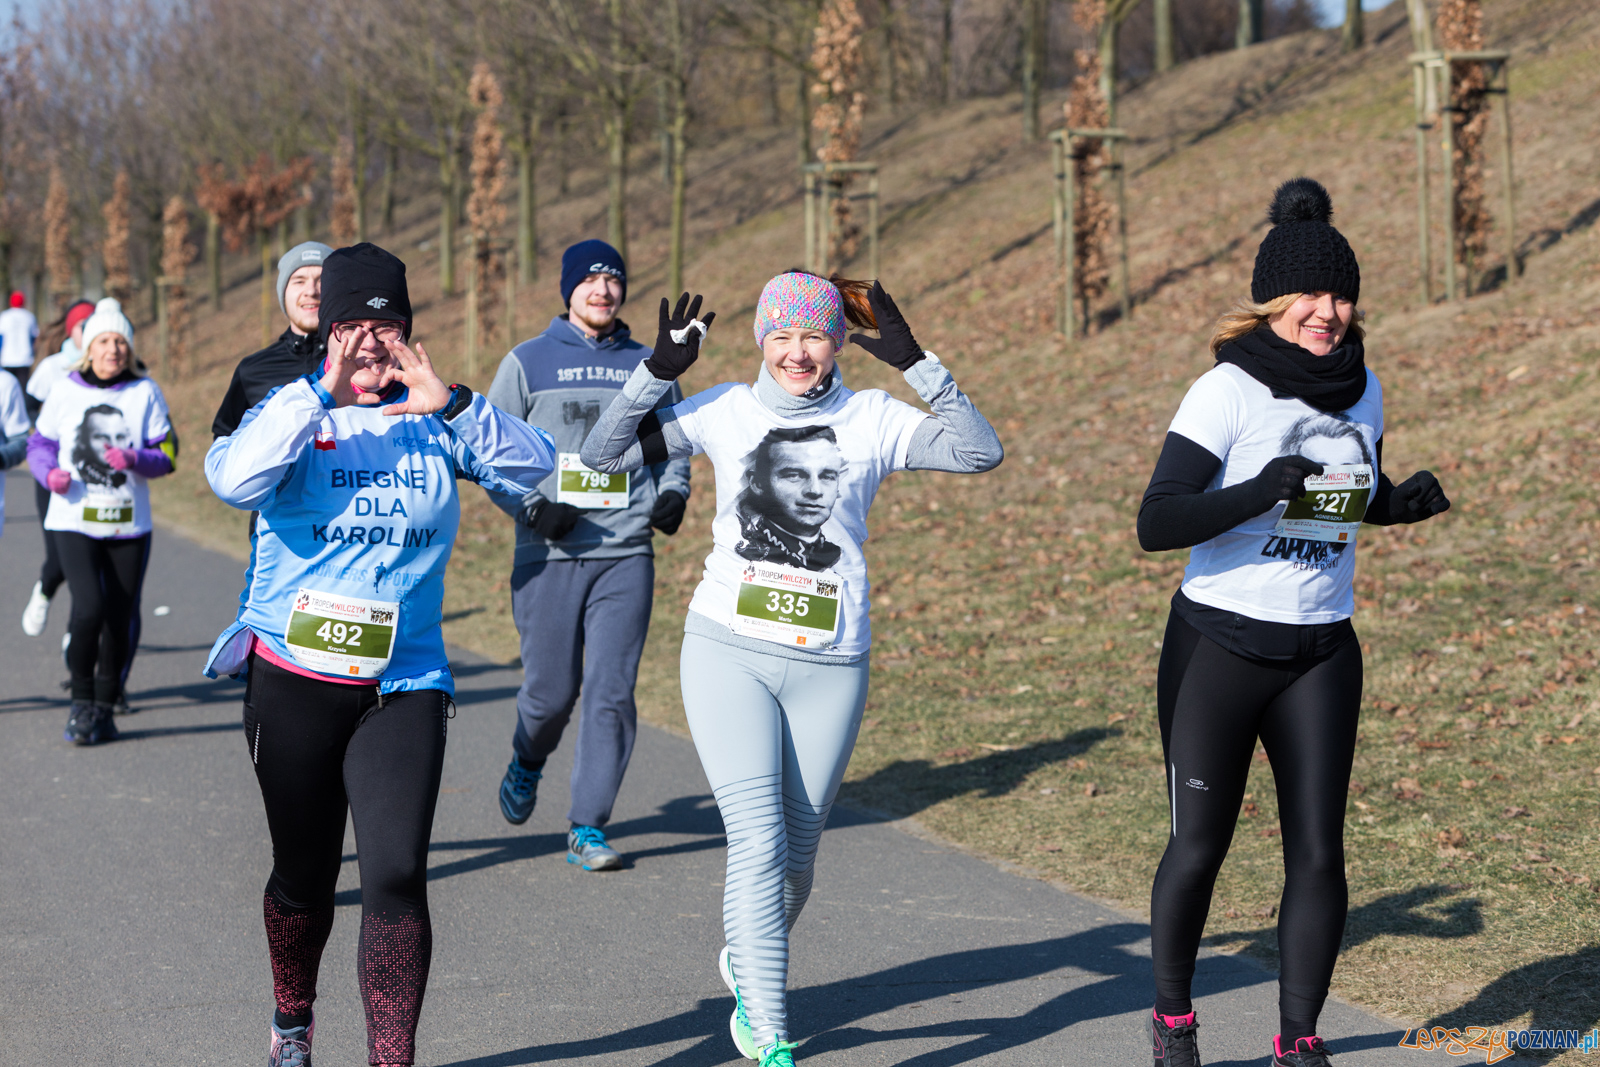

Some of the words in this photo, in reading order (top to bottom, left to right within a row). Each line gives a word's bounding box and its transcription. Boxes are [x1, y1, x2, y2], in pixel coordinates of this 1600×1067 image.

[366, 297, 388, 309] 4F
[557, 367, 584, 382] 1ST
[331, 468, 426, 494] BIEGNĘ
[579, 471, 611, 488] 796
[354, 497, 408, 518] DLA
[1312, 493, 1351, 513] 327
[1314, 513, 1344, 521] AGNIESZKA
[312, 524, 438, 548] KAROLINY
[306, 564, 368, 583] RUNNERS
[766, 591, 810, 616] 335
[316, 621, 363, 646] 492
